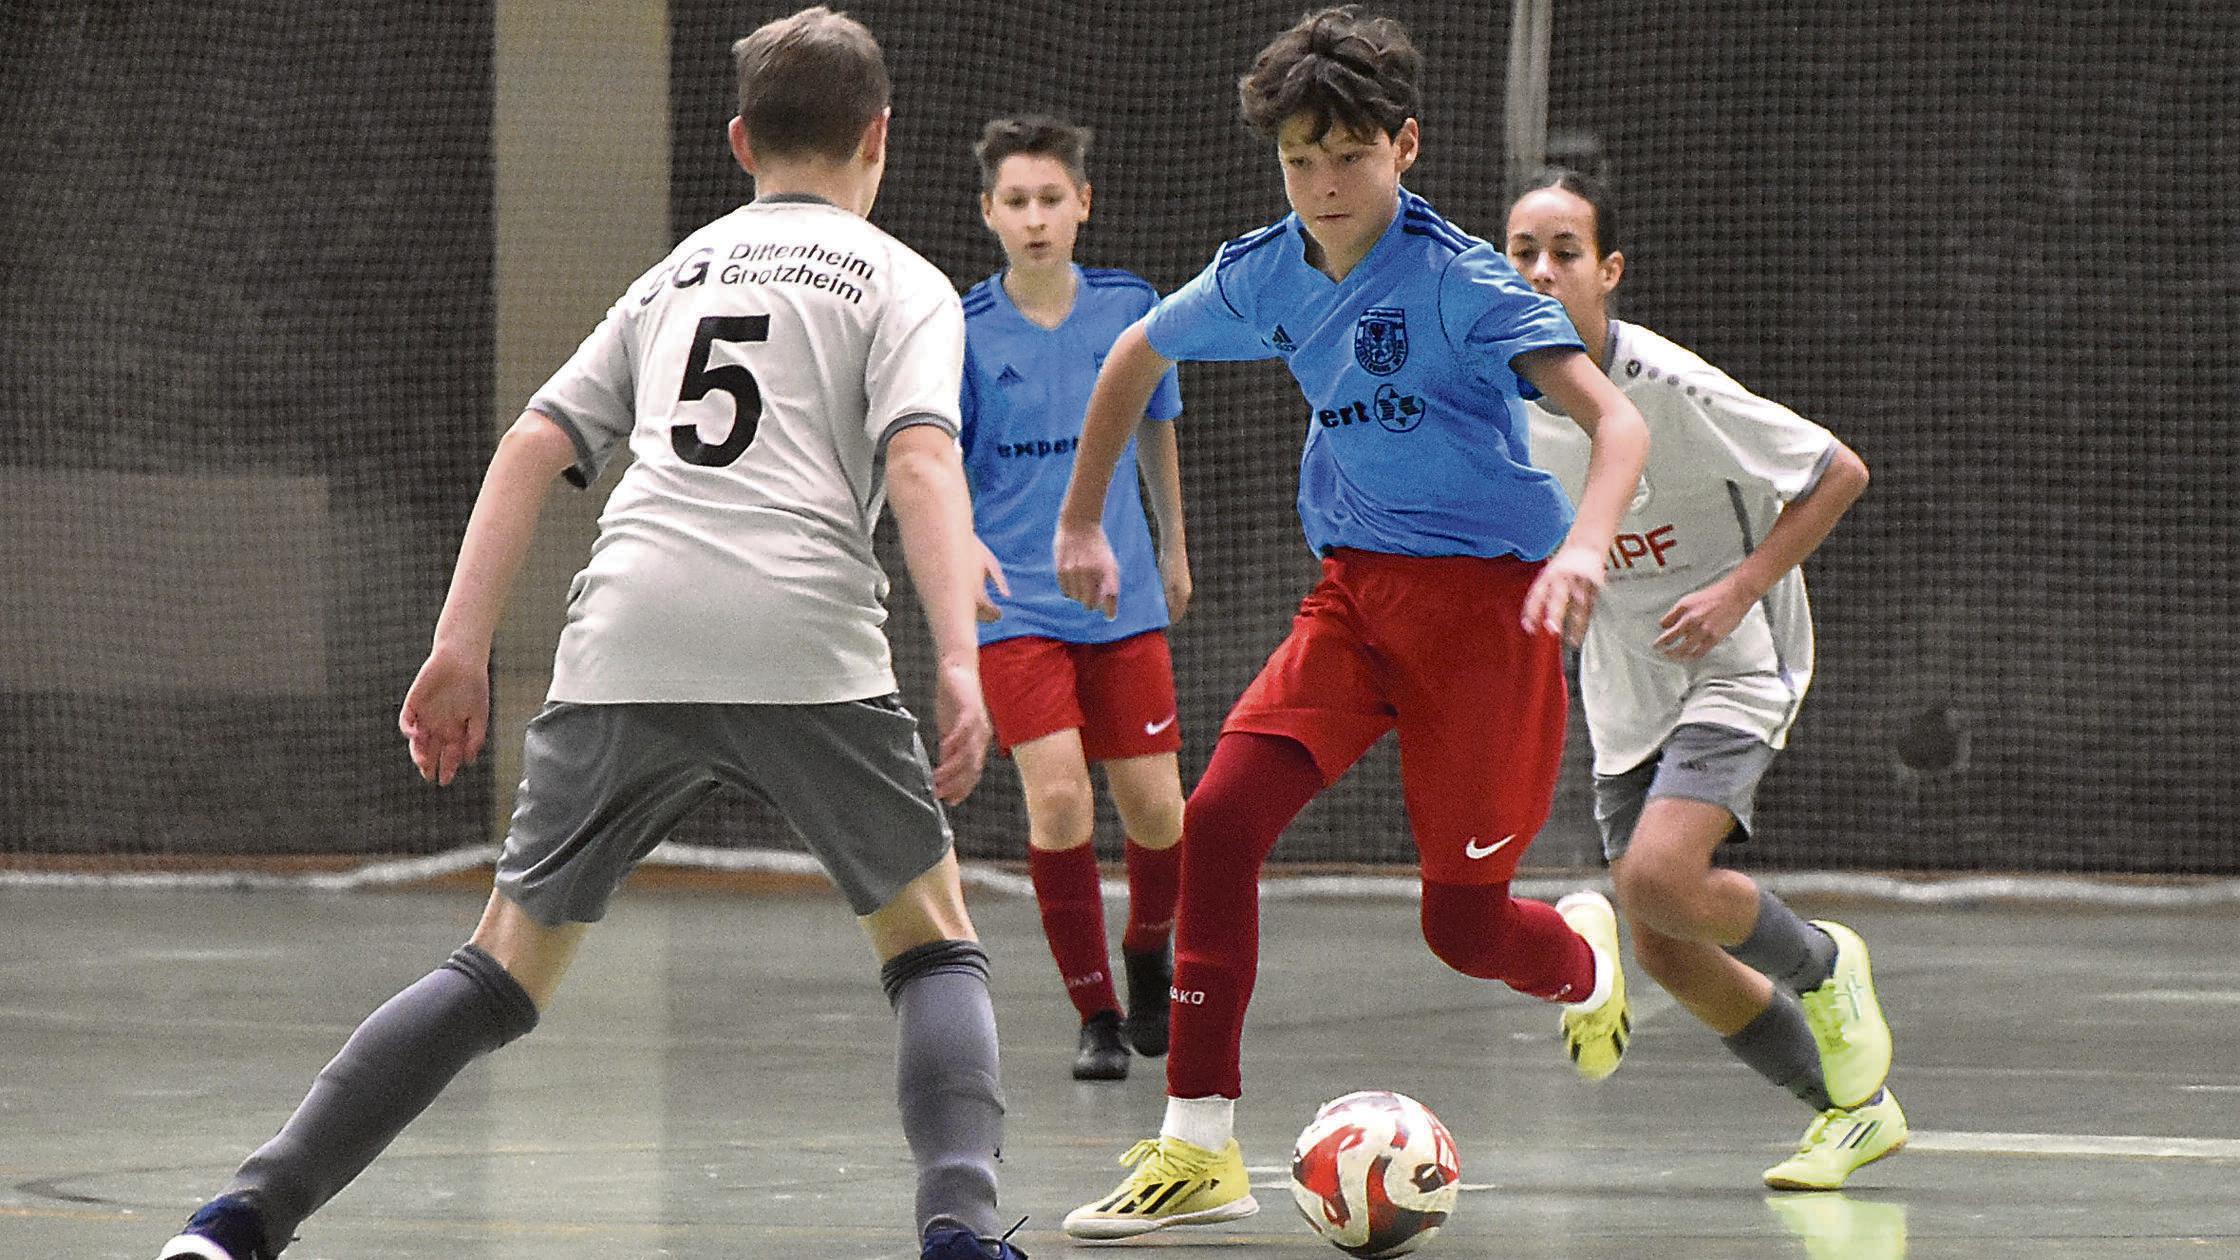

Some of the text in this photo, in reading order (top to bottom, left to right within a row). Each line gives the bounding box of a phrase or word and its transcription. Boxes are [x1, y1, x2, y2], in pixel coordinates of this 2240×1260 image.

[720, 264, 863, 304] Gnotzheim
[671, 314, 770, 467] 5
[1319, 401, 1370, 428] ert
[1169, 985, 1205, 1005] AKO
